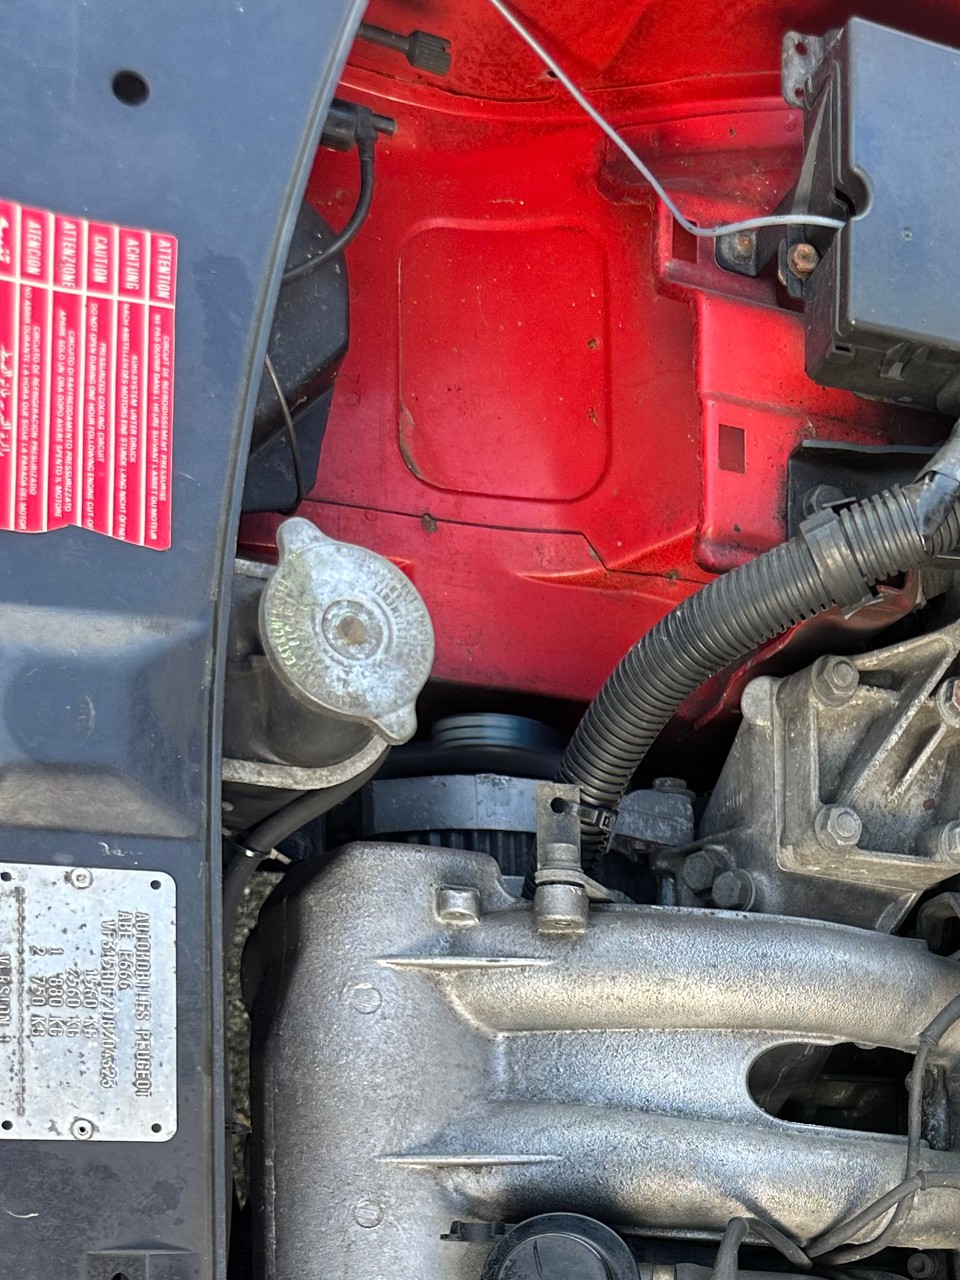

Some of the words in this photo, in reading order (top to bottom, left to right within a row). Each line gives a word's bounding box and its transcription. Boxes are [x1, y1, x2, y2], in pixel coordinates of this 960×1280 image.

[27, 221, 42, 275] ATENCION
[62, 222, 77, 288] ATTENZIONE
[94, 236, 108, 283] CAUTION
[126, 238, 139, 290] ACHTUNG
[157, 240, 172, 299] ATTENTION
[33, 364, 40, 374] DE
[162, 368, 169, 378] DE
[66, 377, 74, 449] RAFFREDDAMENTO
[118, 911, 133, 940] ABE
[30, 946, 46, 956] 2
[118, 950, 133, 990] E666
[135, 912, 151, 1021] AUTOMOBILES
[30, 976, 47, 1006] 750
[48, 977, 64, 1007] 880
[66, 968, 80, 1008] 2560
[83, 969, 99, 1008] 1560
[31, 1016, 46, 1037] KG
[48, 1016, 64, 1037] KG
[66, 1017, 80, 1038] KG
[83, 1017, 99, 1038] KG
[136, 1029, 152, 1098] PEUGEOT
